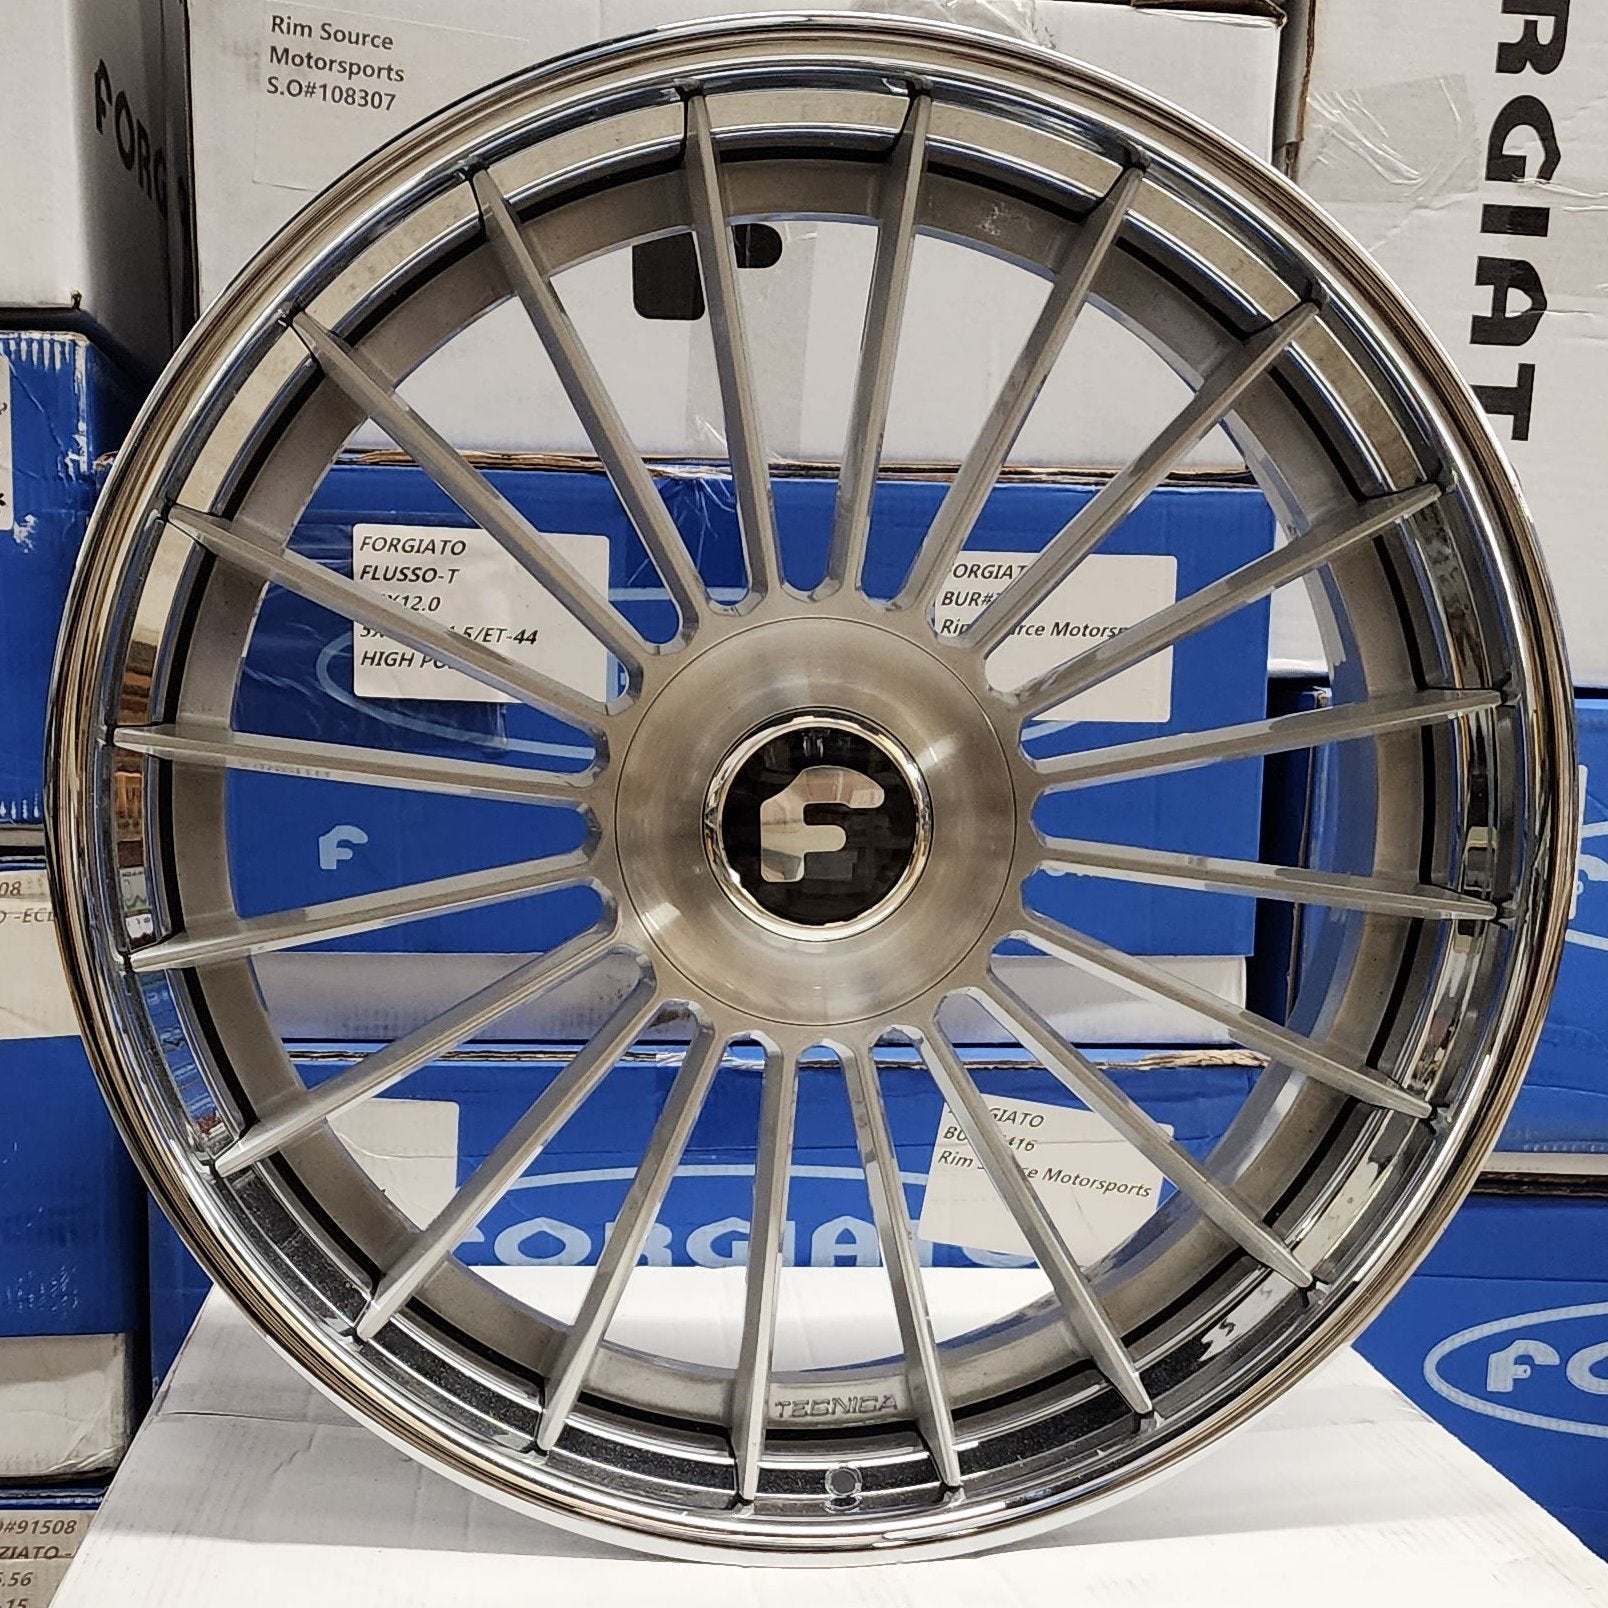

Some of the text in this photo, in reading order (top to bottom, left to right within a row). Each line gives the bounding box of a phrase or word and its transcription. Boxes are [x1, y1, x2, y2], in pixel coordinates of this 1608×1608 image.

[271, 15, 394, 50] Rim Source
[269, 45, 405, 82] Motorsports
[266, 76, 397, 111] S.O#108307
[360, 536, 467, 556] FORGIATO
[360, 565, 460, 584] FLUSSO-T
[941, 591, 1001, 607] BUR#
[361, 651, 415, 668] HIGH
[938, 1150, 974, 1168] Rim
[1042, 1168, 1152, 1198] Motorsports
[0, 1519, 78, 1535] #91508
